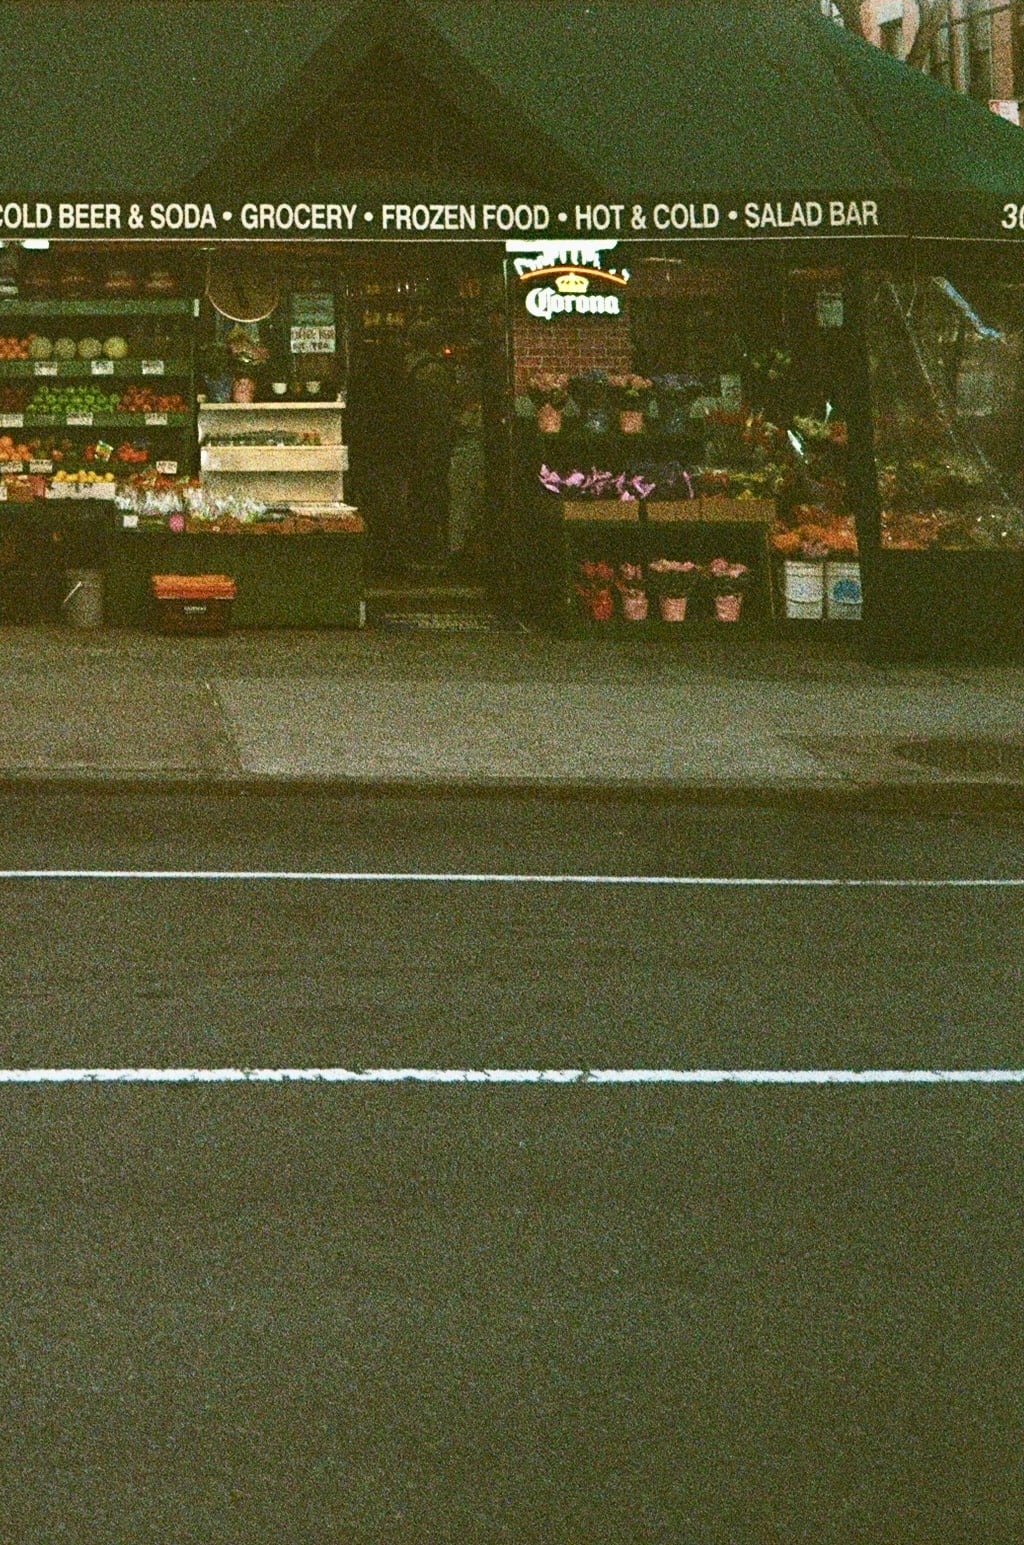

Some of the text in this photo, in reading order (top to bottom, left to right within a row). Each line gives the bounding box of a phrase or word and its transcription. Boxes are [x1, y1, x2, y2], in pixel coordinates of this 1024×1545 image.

[58, 202, 121, 229] BEER
[127, 203, 144, 230] &
[150, 202, 217, 230] SODA
[240, 203, 358, 230] GROCERY
[382, 203, 476, 231] FROZEN
[482, 203, 550, 231] FOOD
[575, 203, 625, 231] HOT
[631, 204, 647, 230] &
[653, 203, 720, 230] COLD
[744, 201, 823, 229] SALAD
[829, 200, 878, 226] BAR
[525, 286, 620, 320] Corona
